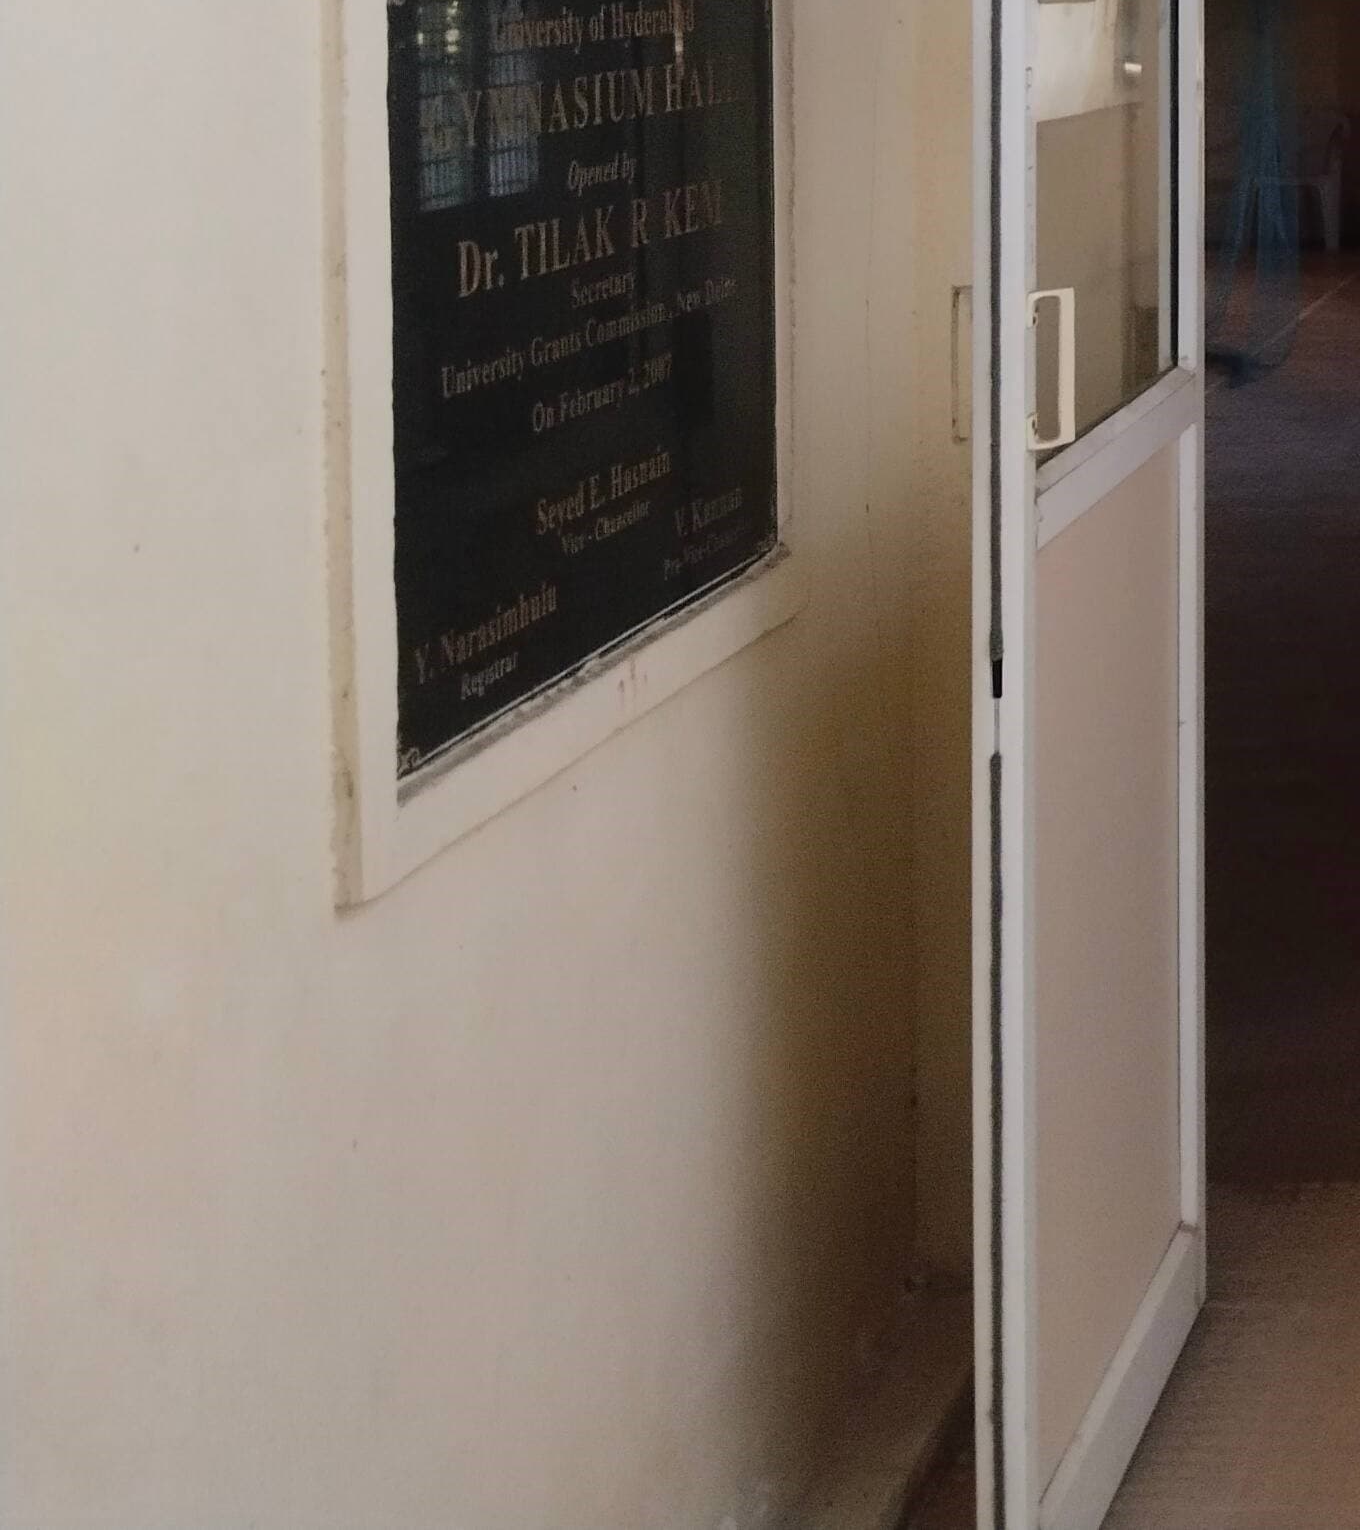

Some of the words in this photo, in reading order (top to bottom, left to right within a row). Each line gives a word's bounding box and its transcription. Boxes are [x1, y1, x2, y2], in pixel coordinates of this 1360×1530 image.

[588, 3, 607, 42] of
[566, 152, 619, 197] Opened
[620, 150, 636, 185] by
[456, 240, 506, 299] Dr.
[513, 205, 616, 282] TILAK
[630, 199, 651, 249] R
[662, 179, 724, 240] KEM
[569, 271, 637, 311] Secretary
[440, 346, 525, 399] University
[529, 331, 583, 368] Grants
[531, 401, 555, 434] On
[558, 379, 626, 423] February
